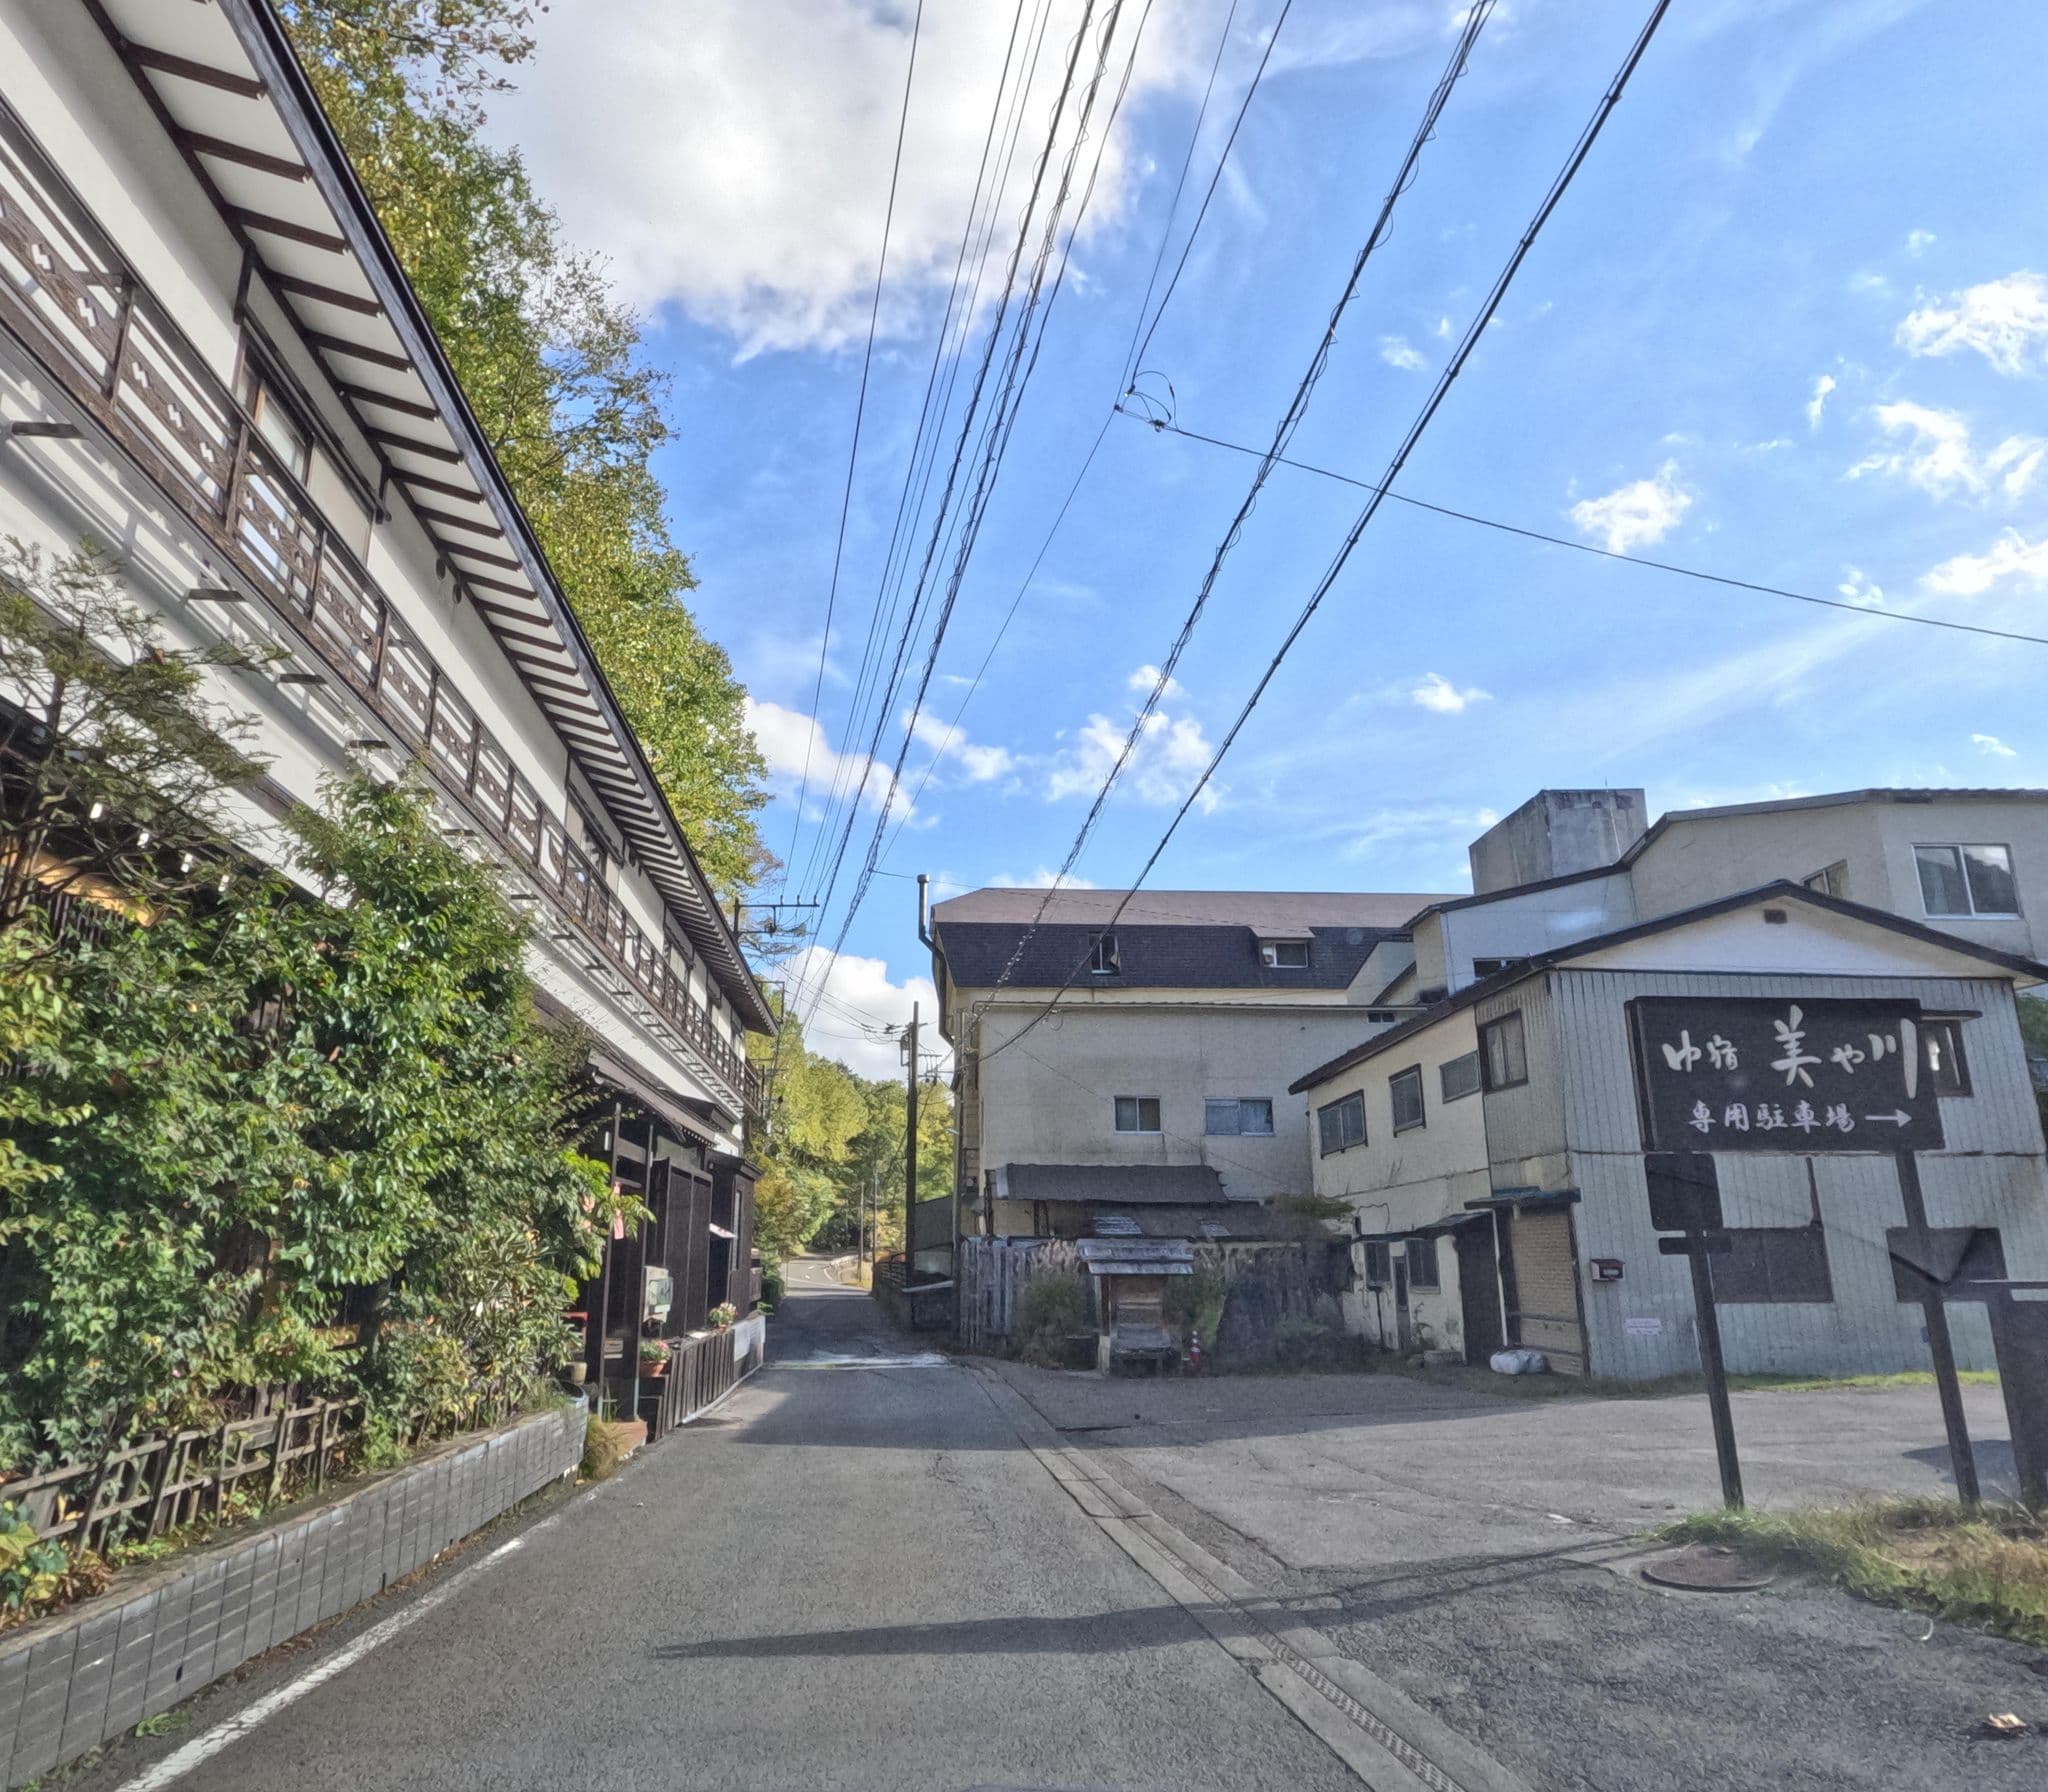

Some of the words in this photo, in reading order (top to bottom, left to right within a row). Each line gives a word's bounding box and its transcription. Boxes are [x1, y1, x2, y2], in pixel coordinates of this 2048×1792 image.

[1770, 1004, 1918, 1099] 美や川
[1688, 1100, 1855, 1134] 専用駐車場
